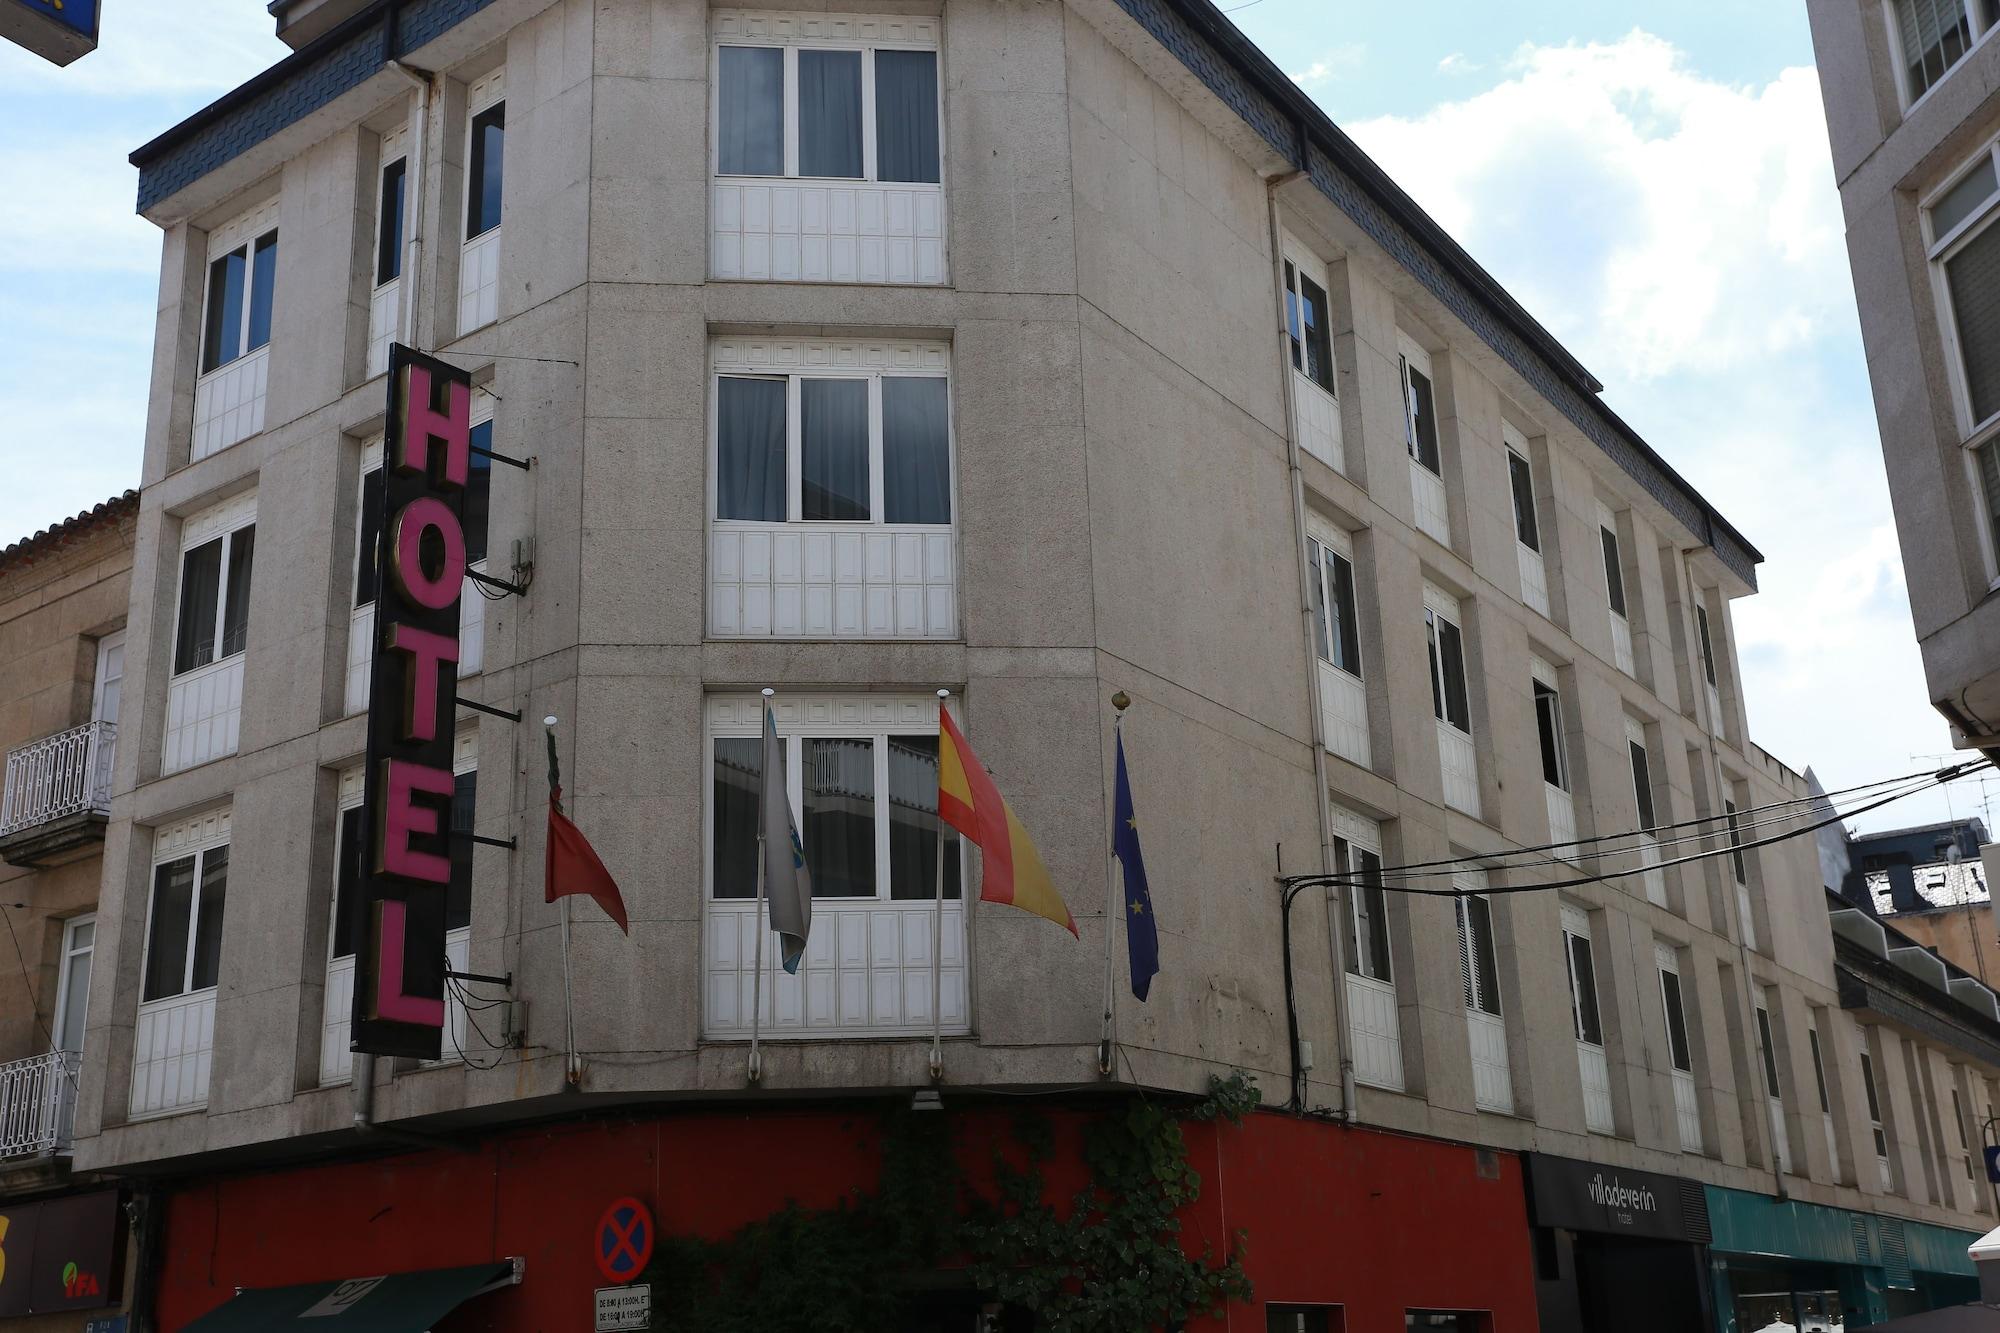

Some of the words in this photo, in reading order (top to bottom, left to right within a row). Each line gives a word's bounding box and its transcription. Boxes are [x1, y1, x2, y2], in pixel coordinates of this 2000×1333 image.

[372, 362, 471, 1028] HOTEL
[600, 1299, 606, 1308] DE
[600, 1313, 606, 1321] DE
